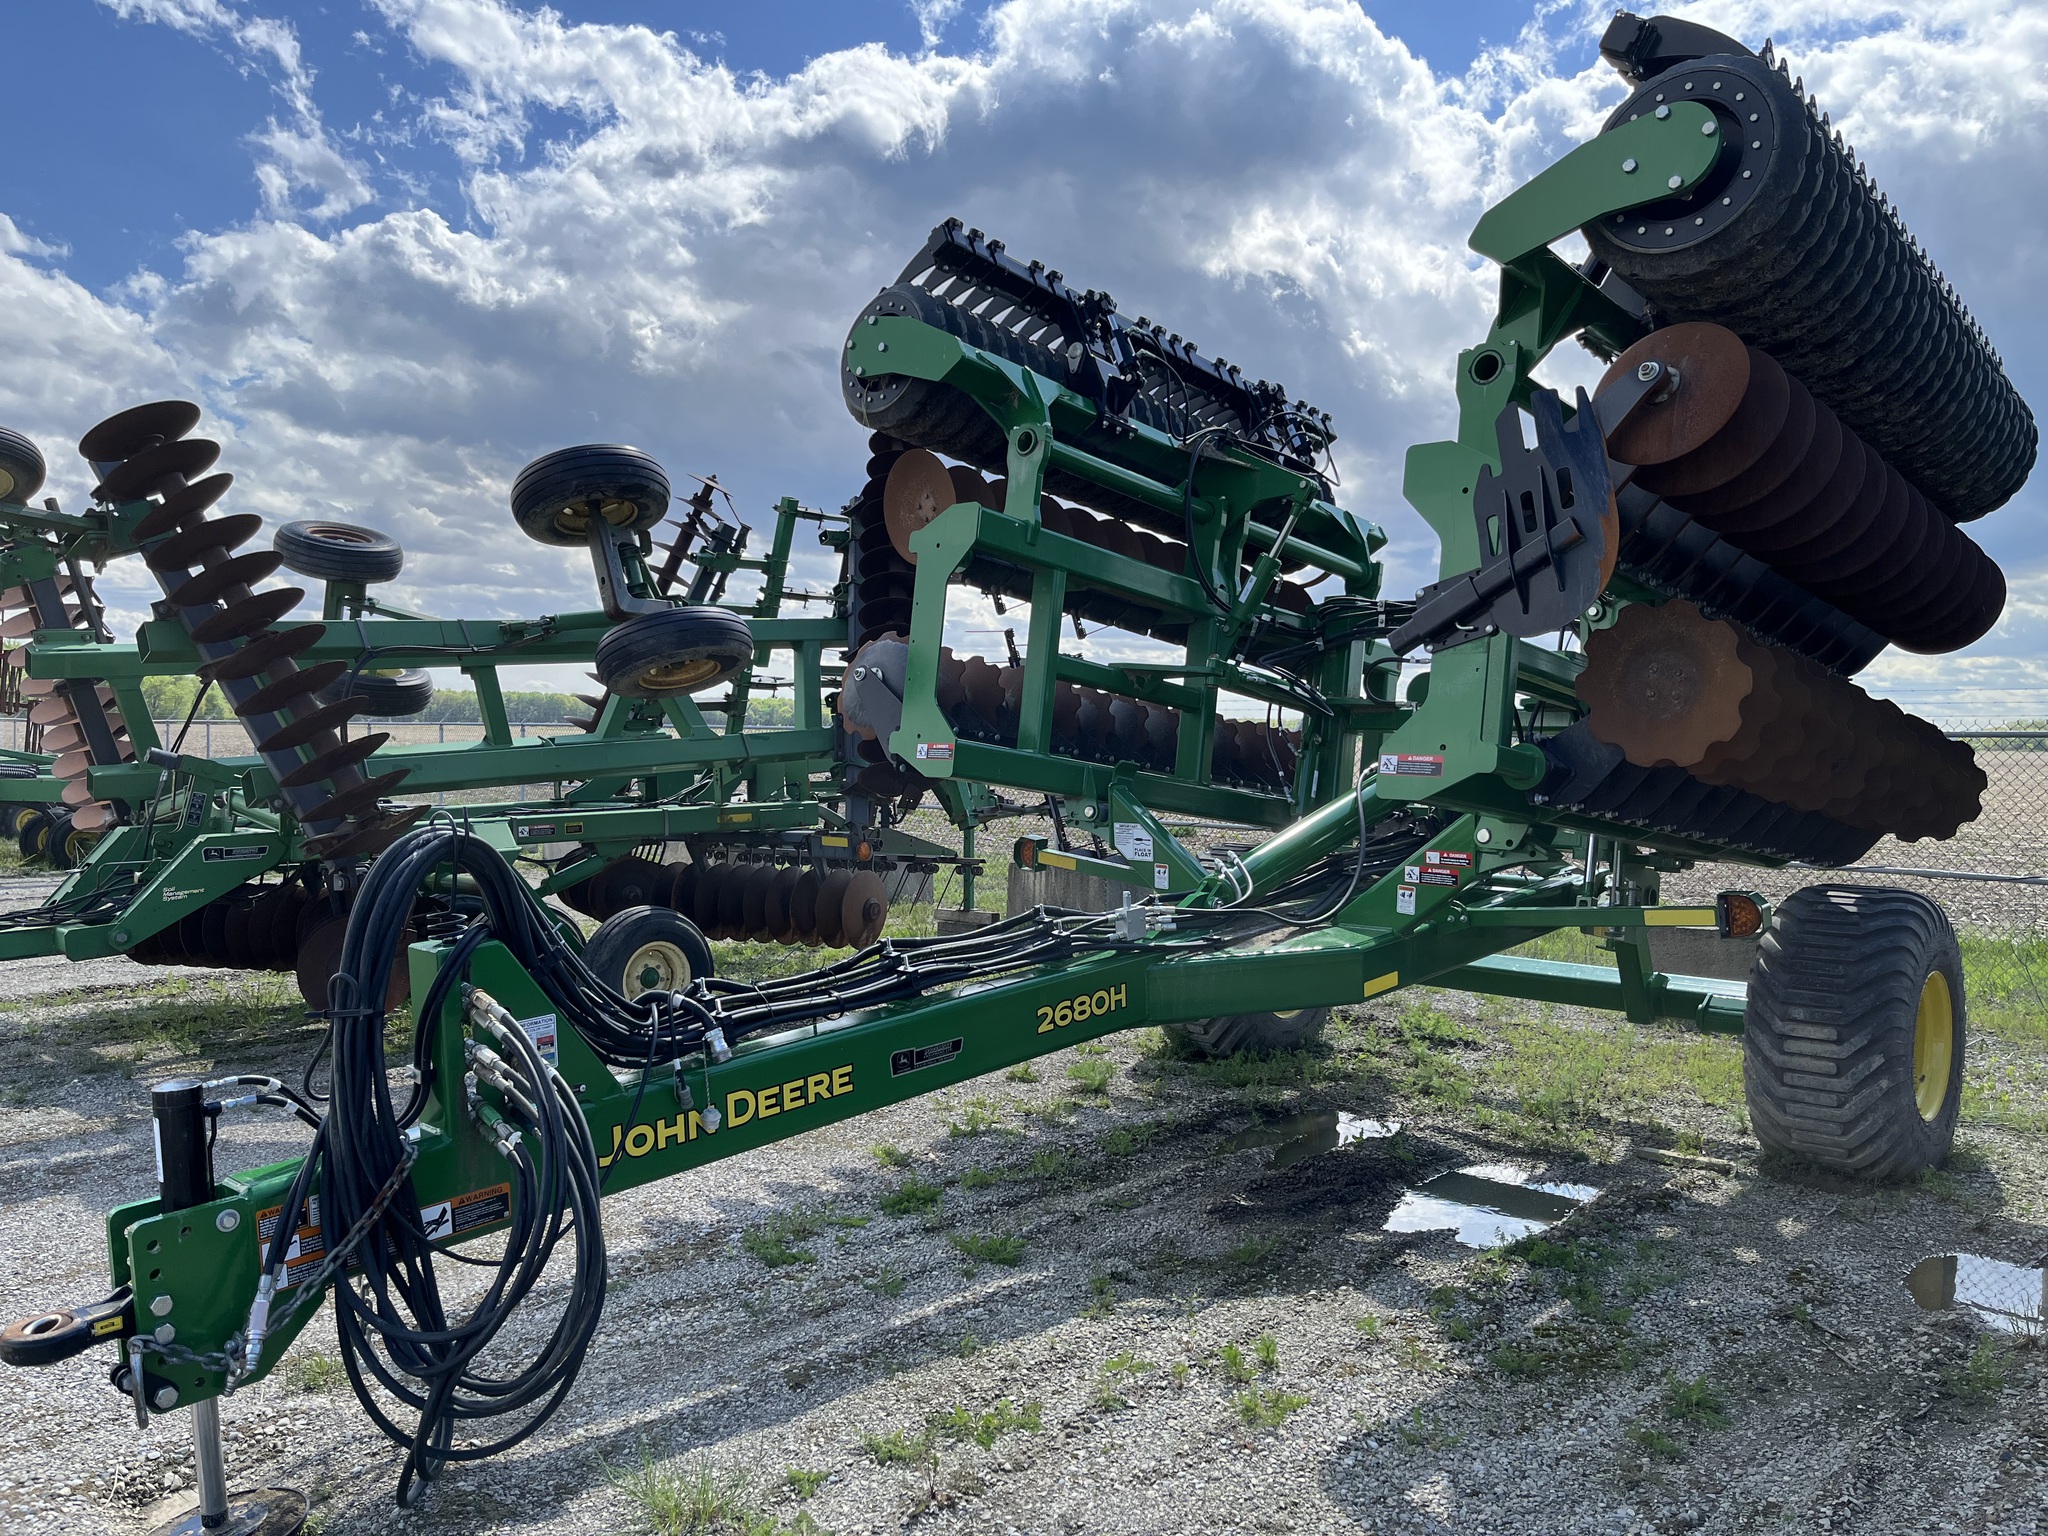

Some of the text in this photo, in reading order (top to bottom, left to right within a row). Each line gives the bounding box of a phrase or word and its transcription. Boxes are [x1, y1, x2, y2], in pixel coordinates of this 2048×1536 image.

[162, 888, 205, 898] Management
[1036, 982, 1127, 1035] 2680H
[598, 1063, 855, 1168] JOHN DEERE
[465, 1186, 503, 1202] WARNING
